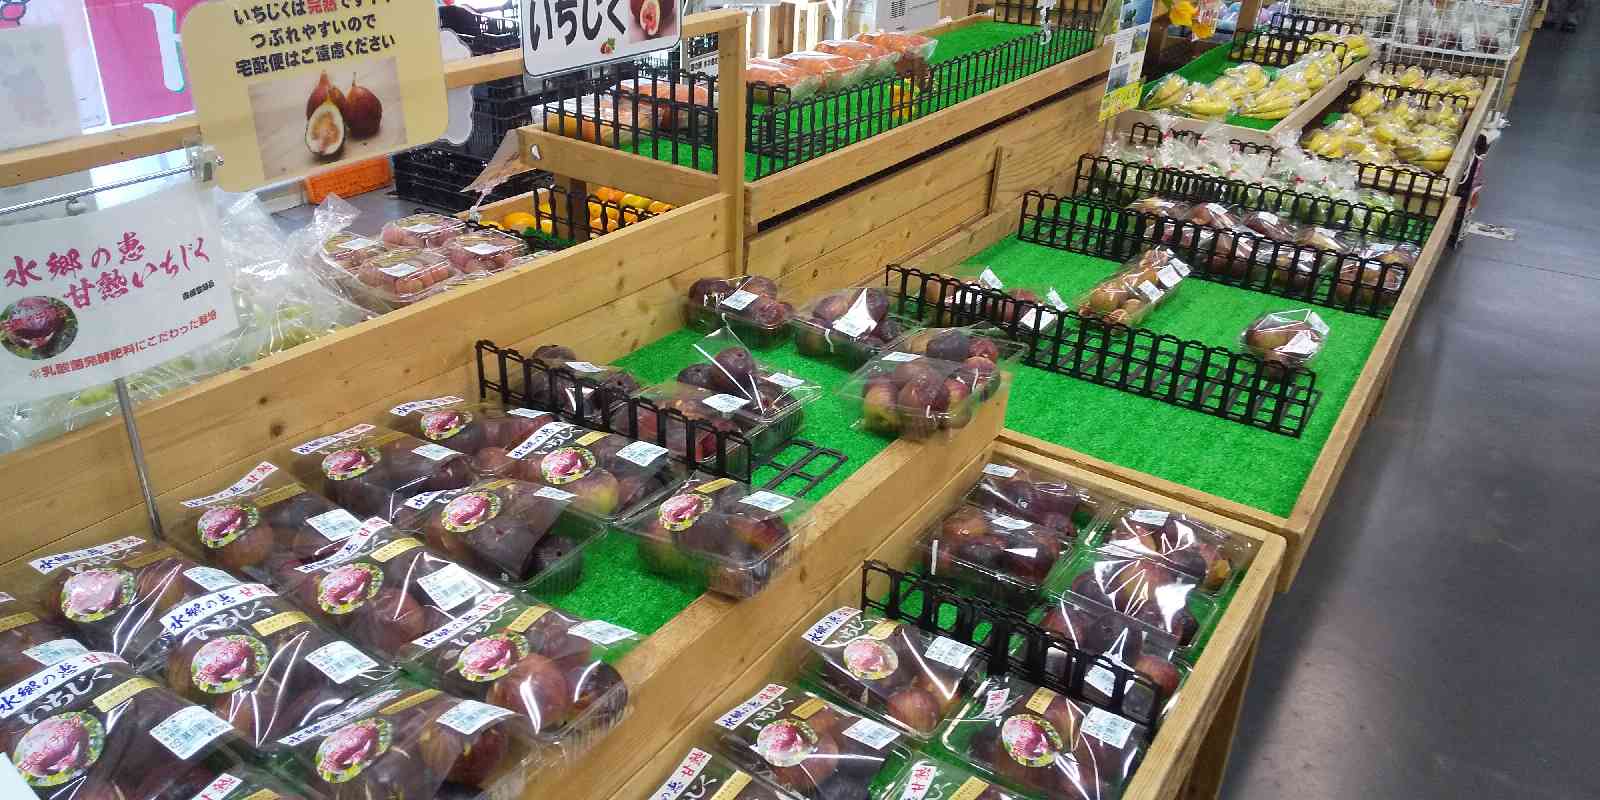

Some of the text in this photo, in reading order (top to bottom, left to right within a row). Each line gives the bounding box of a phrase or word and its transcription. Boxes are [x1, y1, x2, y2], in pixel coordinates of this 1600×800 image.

[250, 14, 377, 48] つぶれやすいので
[529, 0, 626, 51] いちじく
[236, 35, 396, 77] 宅配便はご遠慮ください
[4, 231, 145, 287] 水郷の恵
[64, 237, 210, 309] 甘熟いちじく
